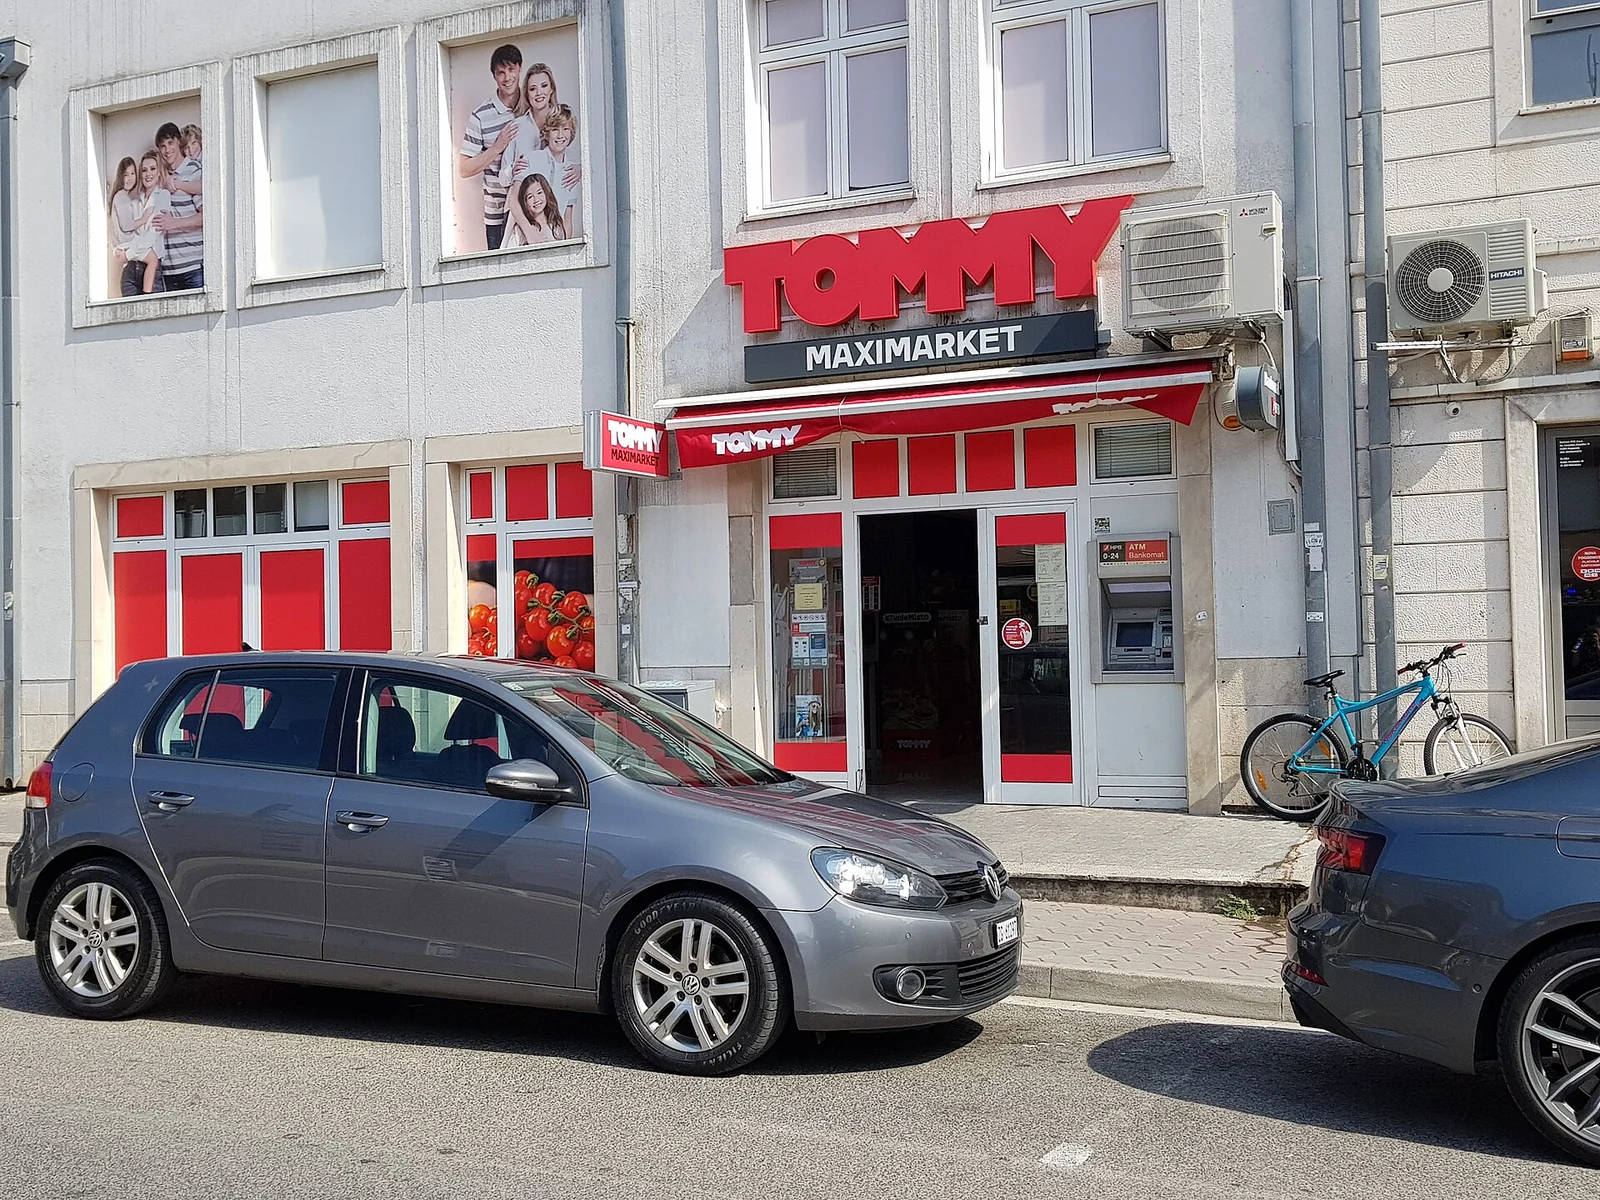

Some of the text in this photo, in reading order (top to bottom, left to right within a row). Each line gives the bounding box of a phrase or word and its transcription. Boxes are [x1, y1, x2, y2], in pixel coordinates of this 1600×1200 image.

[724, 194, 1136, 334] TOMMY
[1490, 269, 1523, 279] HITACHI
[806, 325, 1023, 371] MAXIMARKET
[608, 419, 663, 454] TOMMY
[712, 424, 802, 455] TOMMY
[611, 449, 660, 467] MAXIMARKET
[1103, 552, 1120, 560] 0-24
[897, 739, 932, 749] TOMMY
